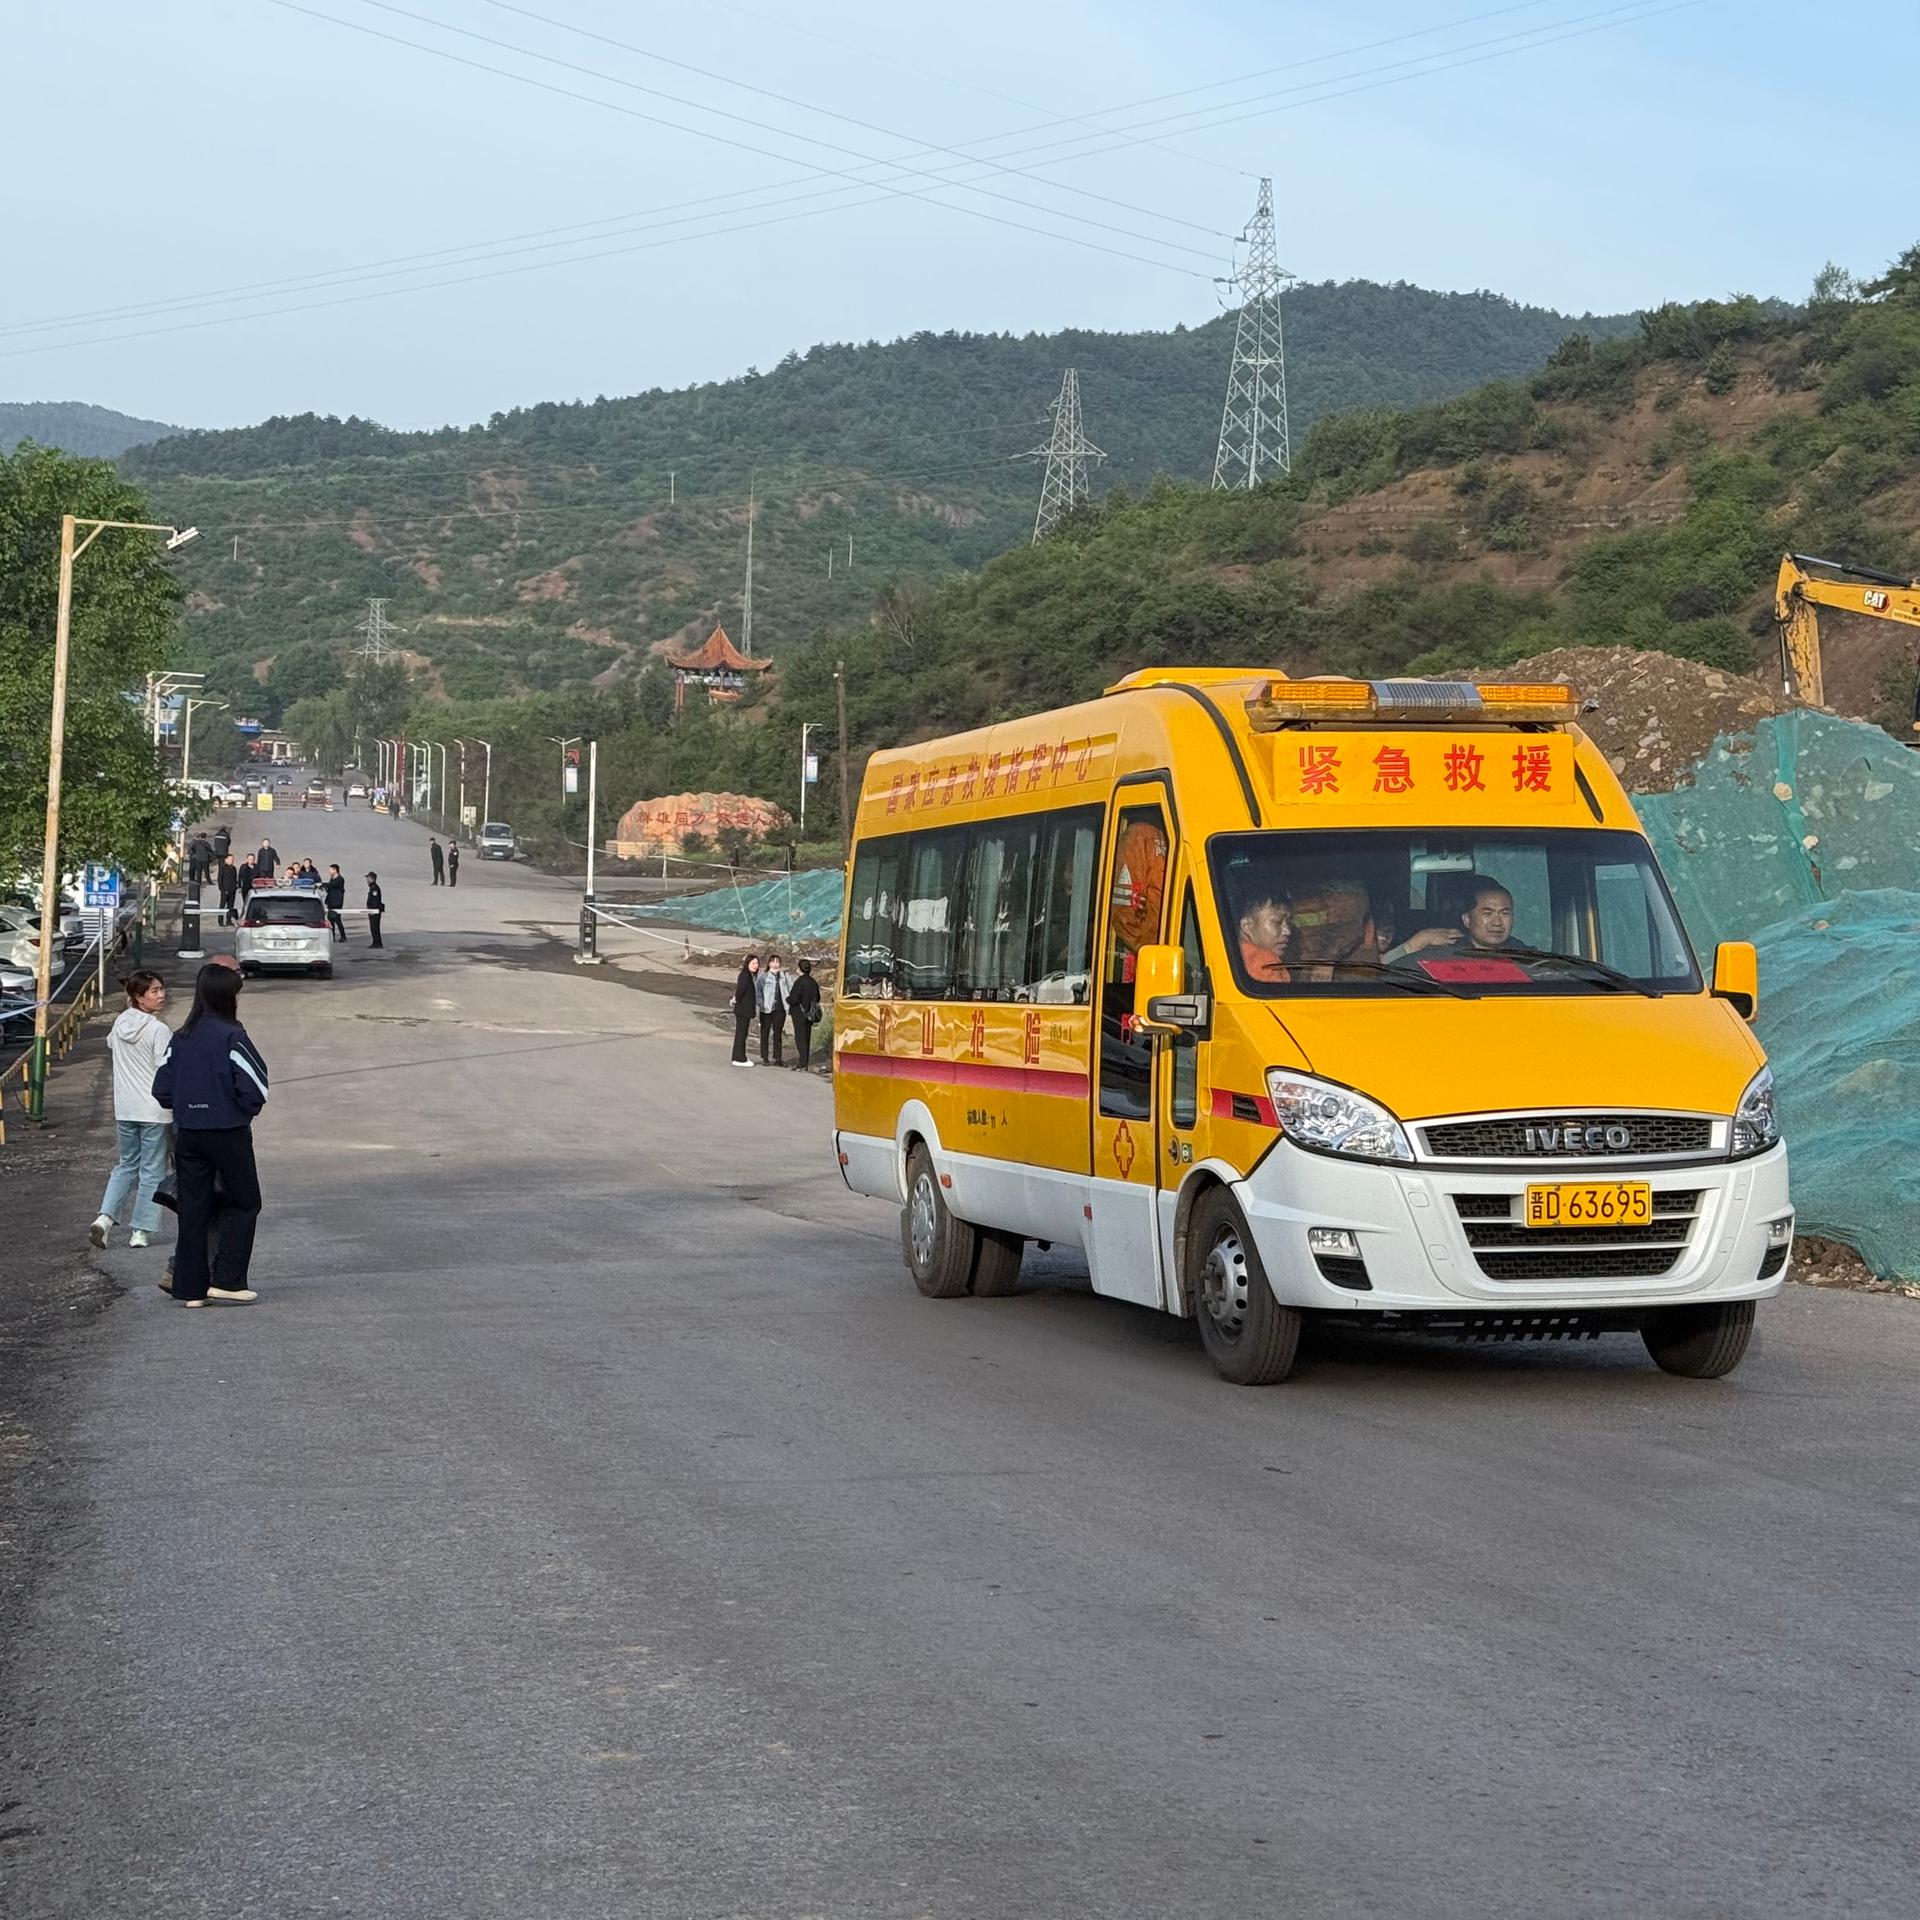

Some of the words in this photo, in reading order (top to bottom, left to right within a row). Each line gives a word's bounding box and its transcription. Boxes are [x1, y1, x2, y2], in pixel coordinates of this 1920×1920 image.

[1864, 590, 1886, 609] CAT
[1299, 744, 1552, 795] 紧急救援
[1525, 1126, 1631, 1151] IVECO
